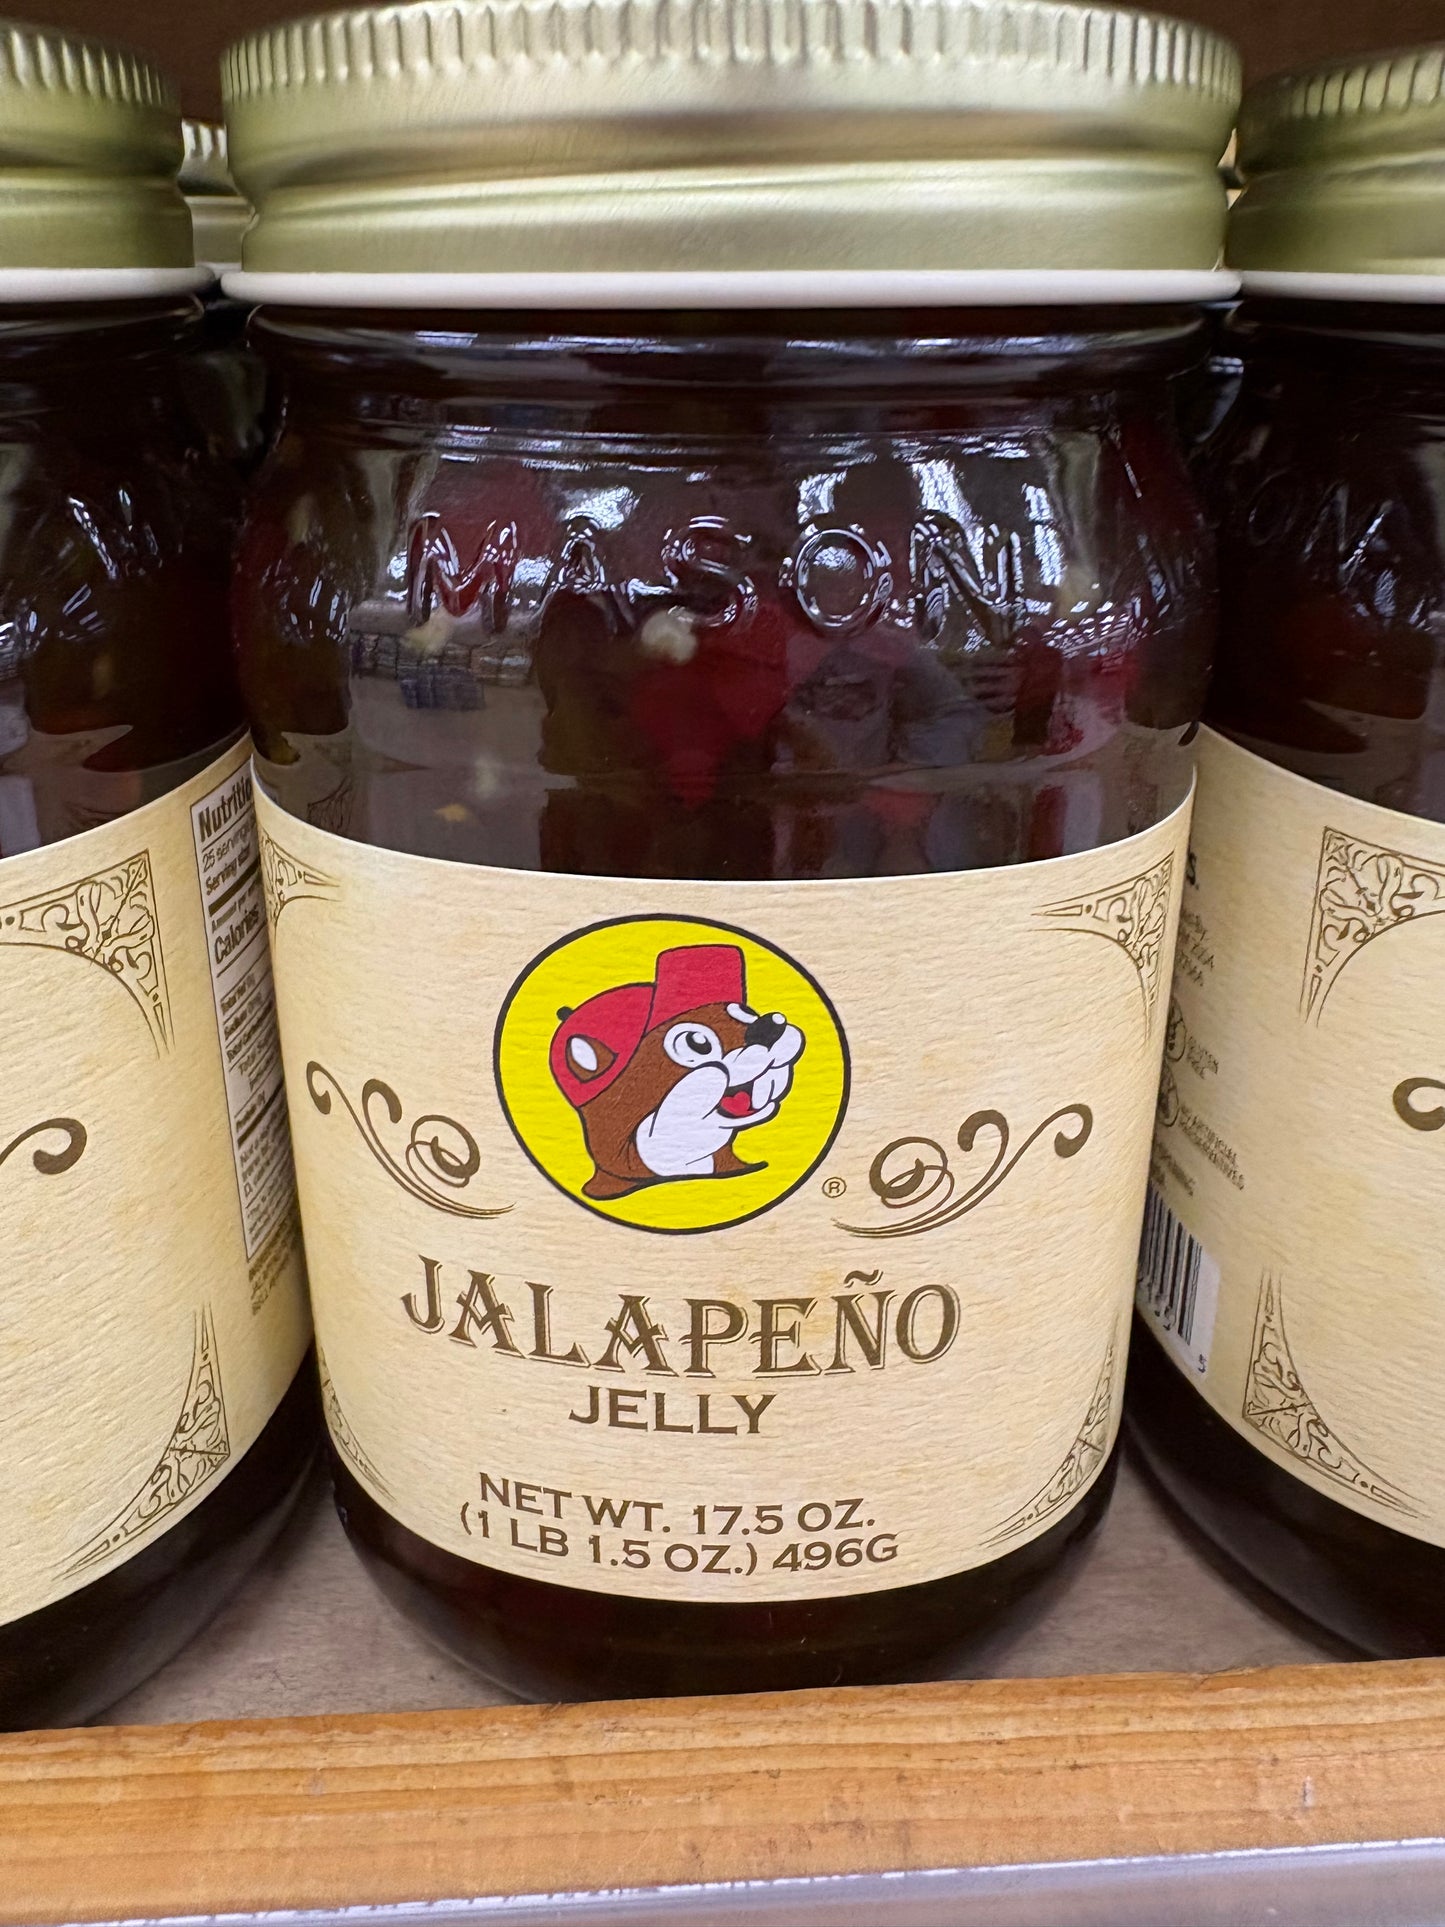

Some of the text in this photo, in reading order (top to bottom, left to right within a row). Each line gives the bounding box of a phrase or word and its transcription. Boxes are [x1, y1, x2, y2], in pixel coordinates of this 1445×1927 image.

[405, 512, 1027, 646] MASON
[401, 1254, 962, 1378] JALAPEÑO
[568, 1385, 777, 1435] JELLY
[460, 1501, 898, 1576] (1 LB 1.5 OZ.) 496G
[480, 1472, 876, 1536] NET WT. 17.5 OZ.
